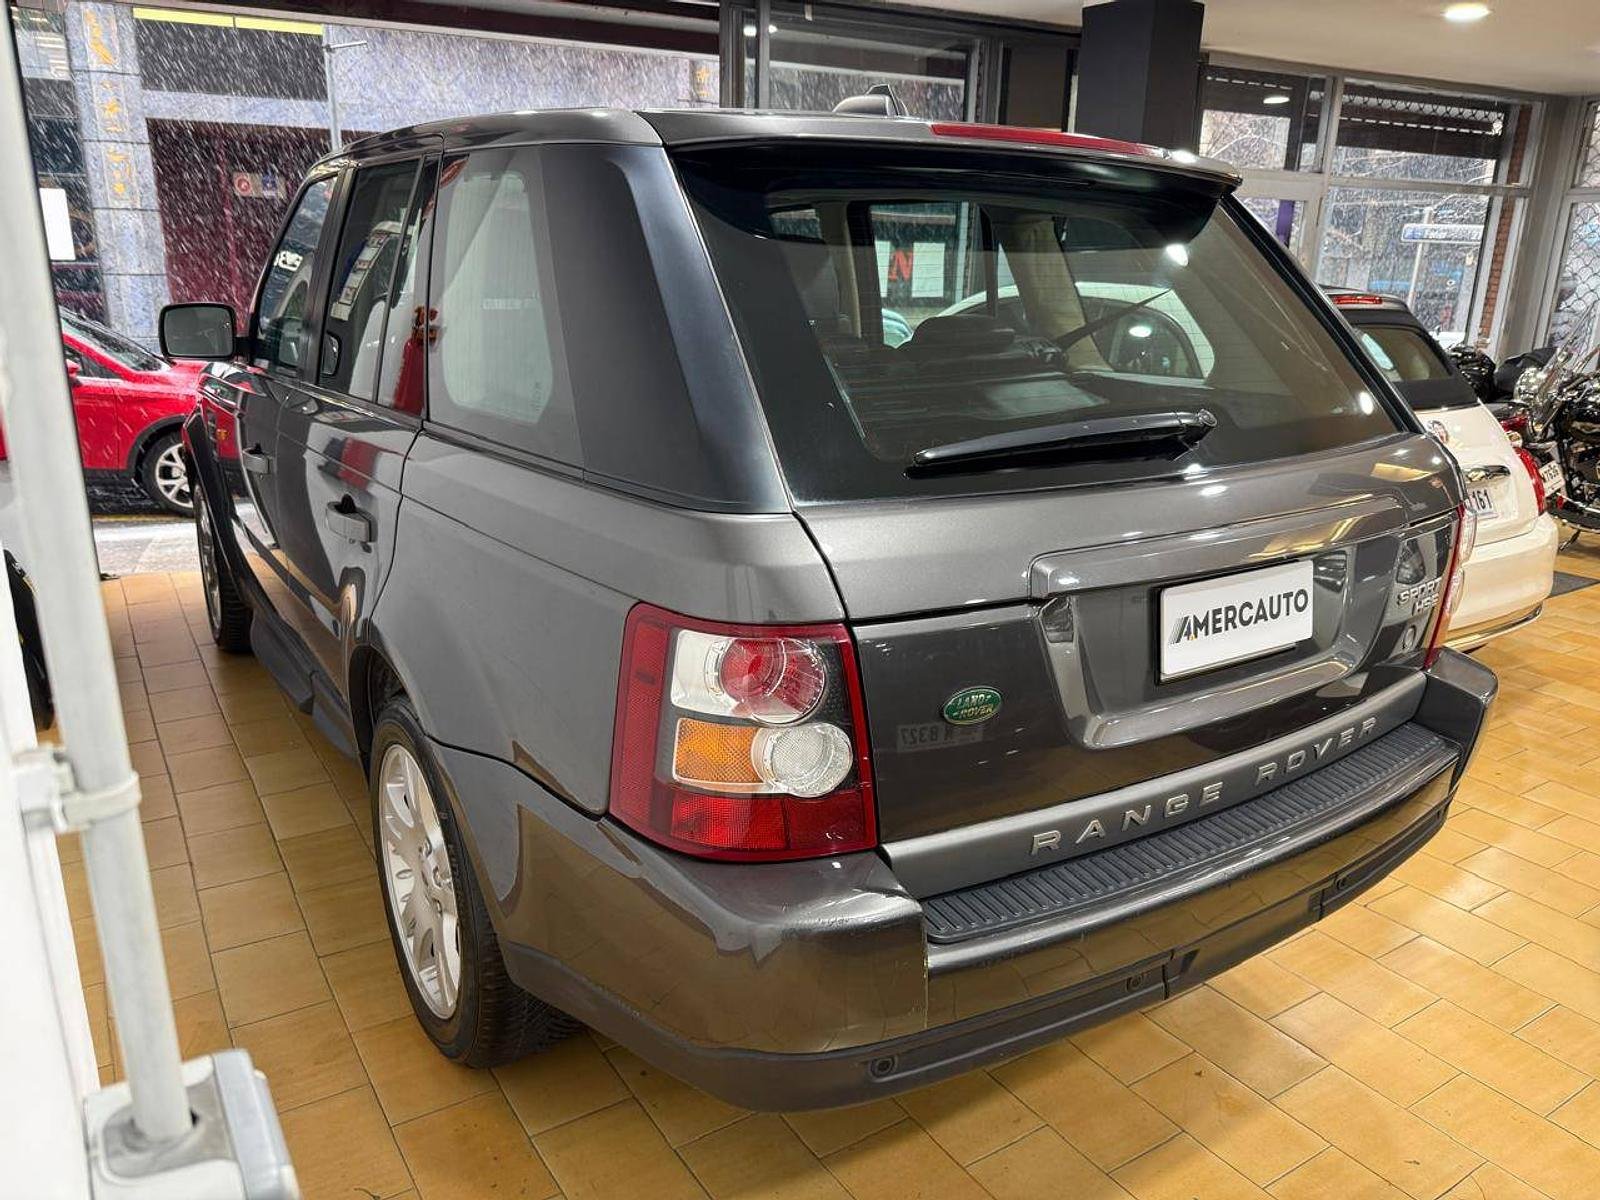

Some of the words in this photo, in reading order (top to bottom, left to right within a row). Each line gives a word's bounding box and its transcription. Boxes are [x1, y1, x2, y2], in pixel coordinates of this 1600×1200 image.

[1398, 577, 1442, 604] SPORT
[1412, 593, 1439, 615] HSE
[1031, 782, 1224, 855] RANGE
[1254, 718, 1376, 786] ROVER
